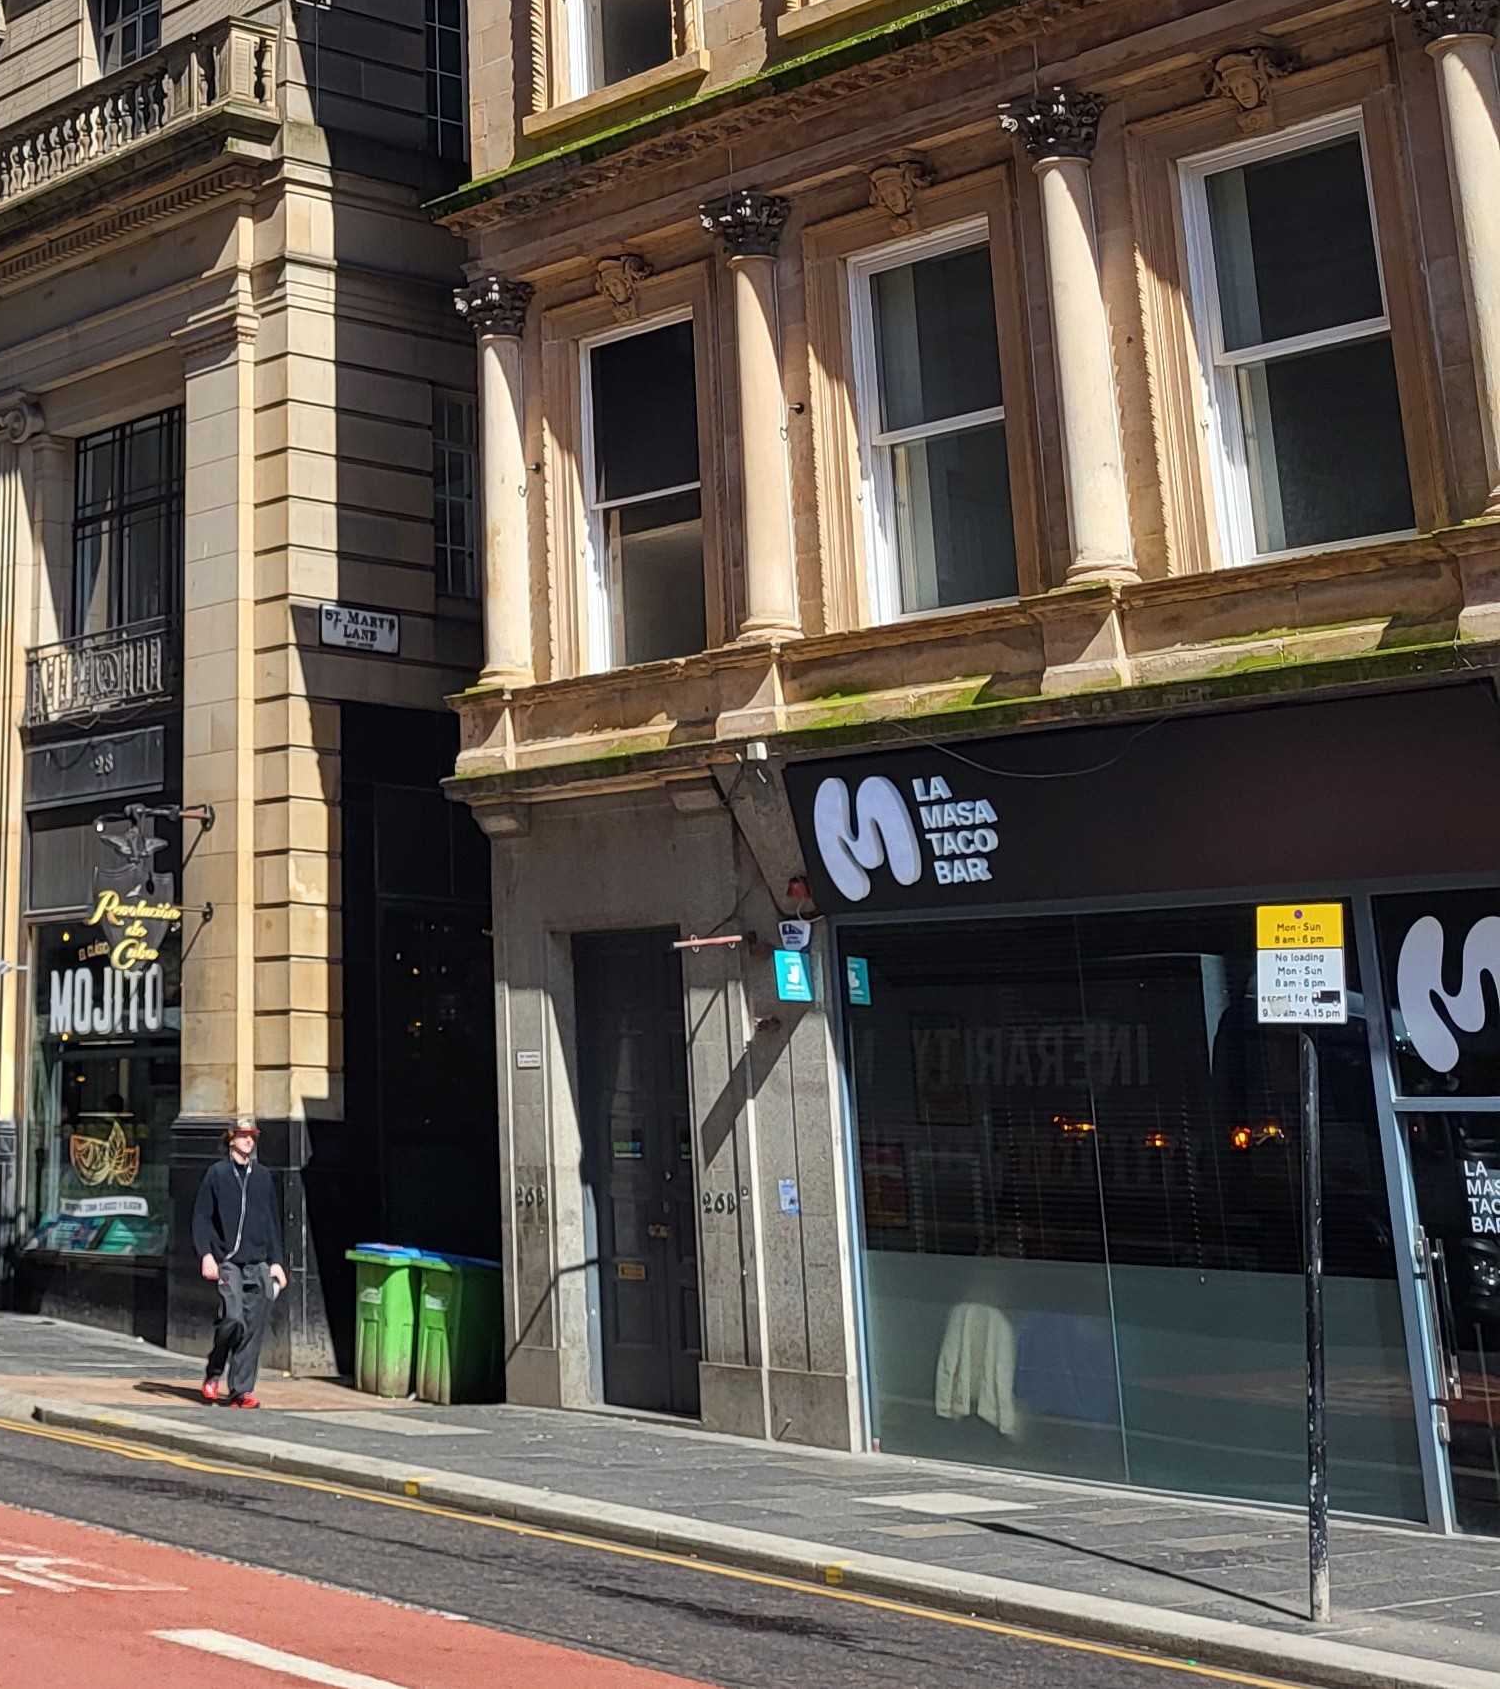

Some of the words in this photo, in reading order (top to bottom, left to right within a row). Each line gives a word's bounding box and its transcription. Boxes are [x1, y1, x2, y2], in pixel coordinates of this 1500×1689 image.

[343, 624, 377, 642] LANE
[912, 776, 952, 801] LA
[919, 799, 998, 829] MASA
[925, 828, 999, 857] TACO
[934, 857, 992, 885] BAR
[1277, 923, 1296, 932] Mon
[1303, 922, 1321, 931] Sun
[1274, 936, 1280, 944] 8
[1302, 935, 1308, 943] 6
[1310, 936, 1324, 944] pm
[1275, 954, 1288, 962] No
[1291, 953, 1324, 963] loading
[1277, 967, 1297, 975] Mon
[1304, 966, 1322, 975] Sun
[1303, 979, 1309, 987] 6
[1311, 980, 1326, 988] pm
[50, 963, 163, 1035] MOJITO
[1295, 994, 1307, 1003] for
[1262, 1009, 1281, 1017] 9.
[1304, 1009, 1324, 1018] 4.15
[1326, 1010, 1340, 1018] pm
[1464, 1160, 1488, 1177] LA
[1466, 1179, 1500, 1196] MA
[702, 1192, 736, 1215] 26B
[1468, 1198, 1500, 1215] TAC
